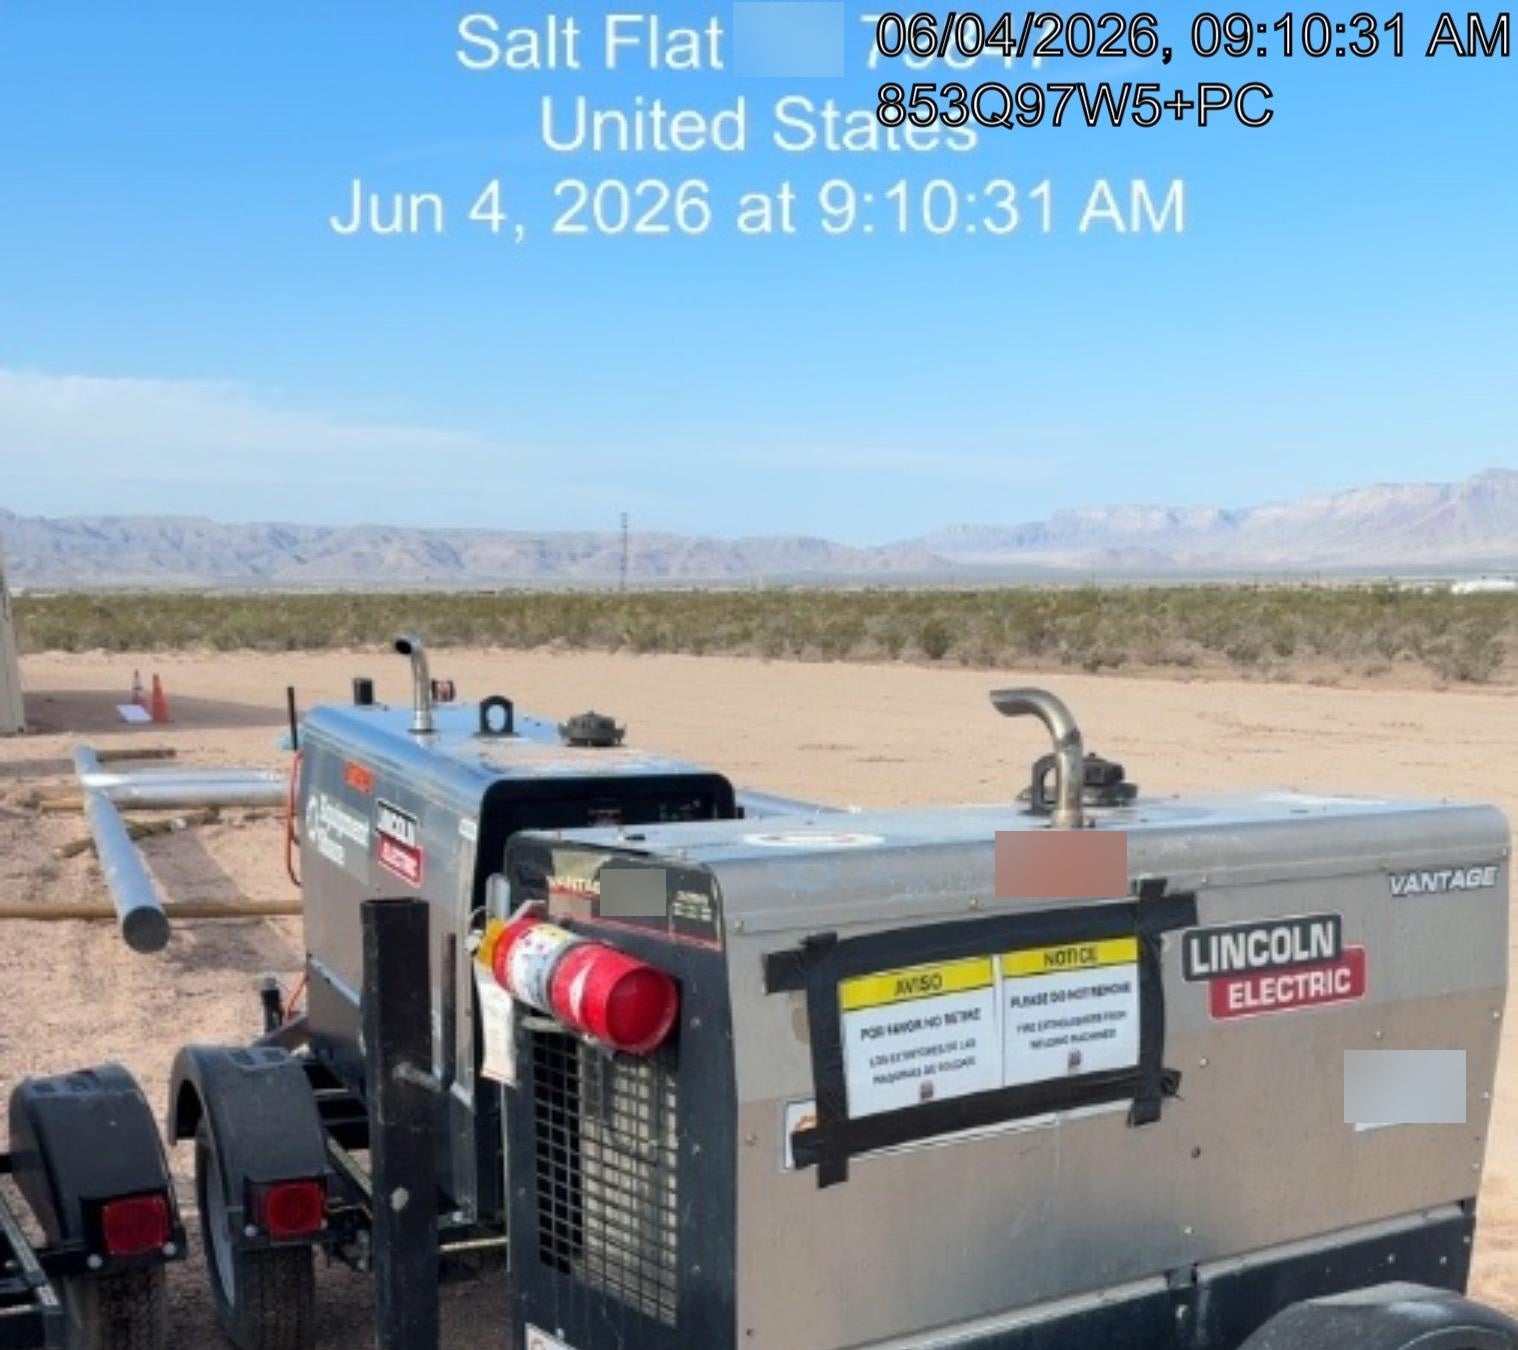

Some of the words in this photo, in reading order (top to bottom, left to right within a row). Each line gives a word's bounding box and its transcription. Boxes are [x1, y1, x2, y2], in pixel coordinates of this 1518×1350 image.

[1390, 866, 1499, 897] VANTAGE
[1043, 947, 1098, 967] NOTICE
[1190, 921, 1335, 976] LINCOLN
[894, 972, 943, 997] AVISO
[1228, 967, 1352, 1010] ELECTRIC
